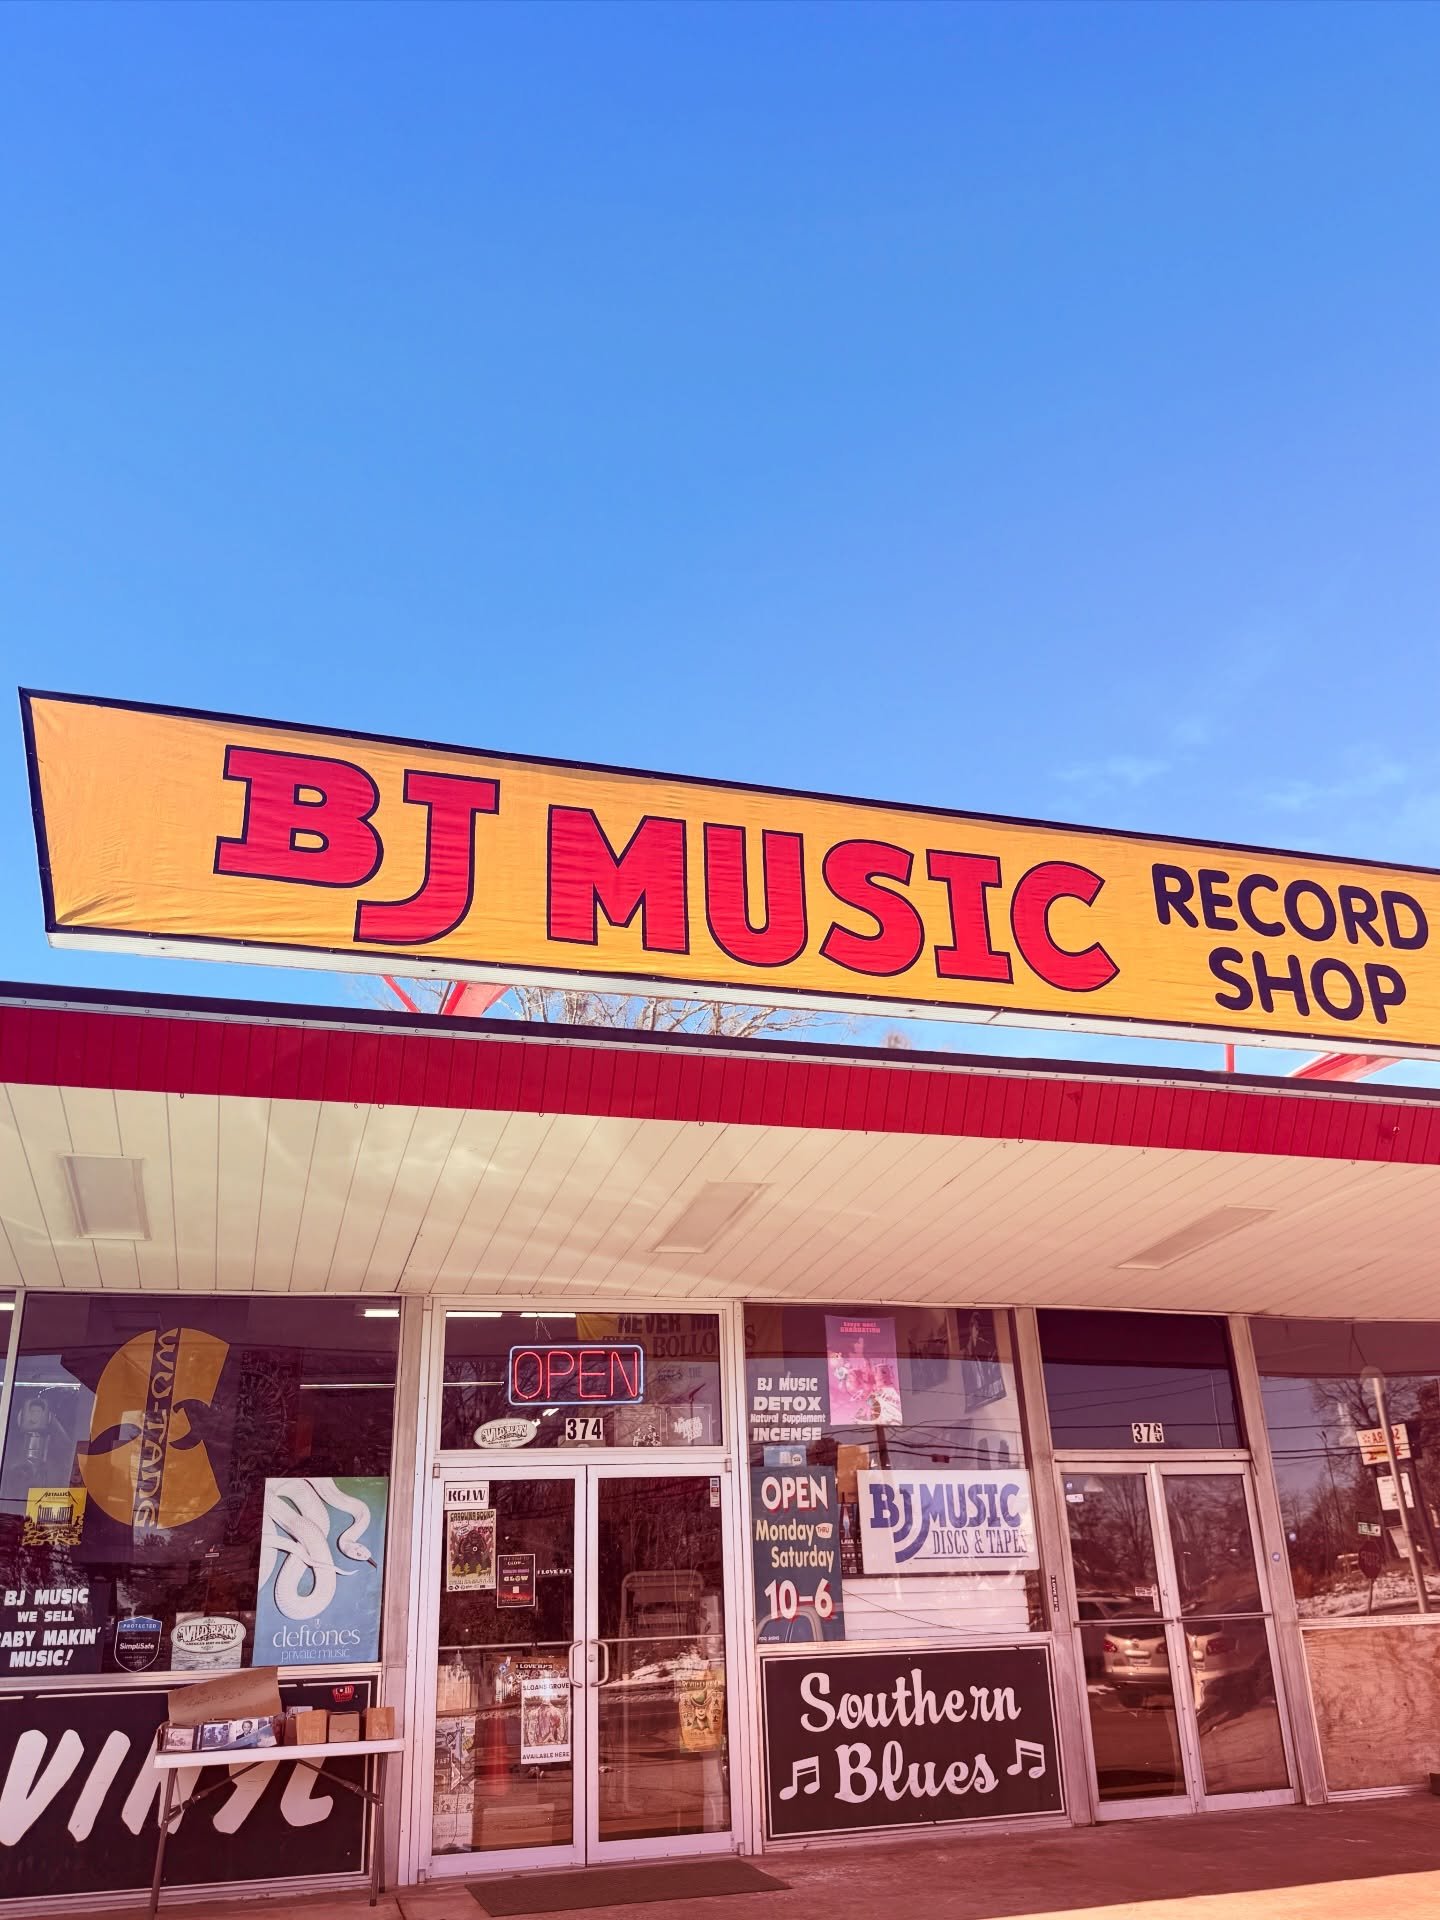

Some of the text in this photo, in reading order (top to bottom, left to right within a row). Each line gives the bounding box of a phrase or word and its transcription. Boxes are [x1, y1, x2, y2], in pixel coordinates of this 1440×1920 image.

[213, 744, 1120, 992] BJ MUSIC
[1152, 863, 1429, 950] RECORD
[1209, 947, 1407, 1024] SHOP
[617, 1315, 681, 1333] NEVER
[514, 1351, 638, 1399] OPEN
[757, 1377, 818, 1391] BJ MUSIC
[753, 1396, 822, 1411] DETOX
[133, 1327, 179, 1528] WU-TANG
[567, 1418, 601, 1439] 374
[750, 1413, 826, 1424] Natural Supplement
[753, 1427, 822, 1440] INCENSE
[1134, 1423, 1162, 1442] 376
[448, 1489, 486, 1502] KGLW
[761, 1475, 829, 1511] OPEN
[869, 1484, 914, 1543] BJ
[755, 1519, 830, 1546] Monday THRU
[932, 1528, 1028, 1555] DISCS & TAPES
[771, 1546, 834, 1572] Saturday
[4, 1588, 89, 1606] BJ MUSIC
[17, 1610, 75, 1622] WE SELL
[0, 1627, 101, 1648] ABY MAKIN'
[177, 1624, 239, 1642] WILD BERRY
[272, 1624, 361, 1648] deftones
[120, 1642, 155, 1651] SimpliSafe
[281, 1645, 351, 1662] private music
[9, 1649, 74, 1668] MUSIC!
[800, 1668, 1022, 1732] Southern
[522, 1752, 553, 1760] AVAILABLE
[834, 1740, 999, 1803] Blues
